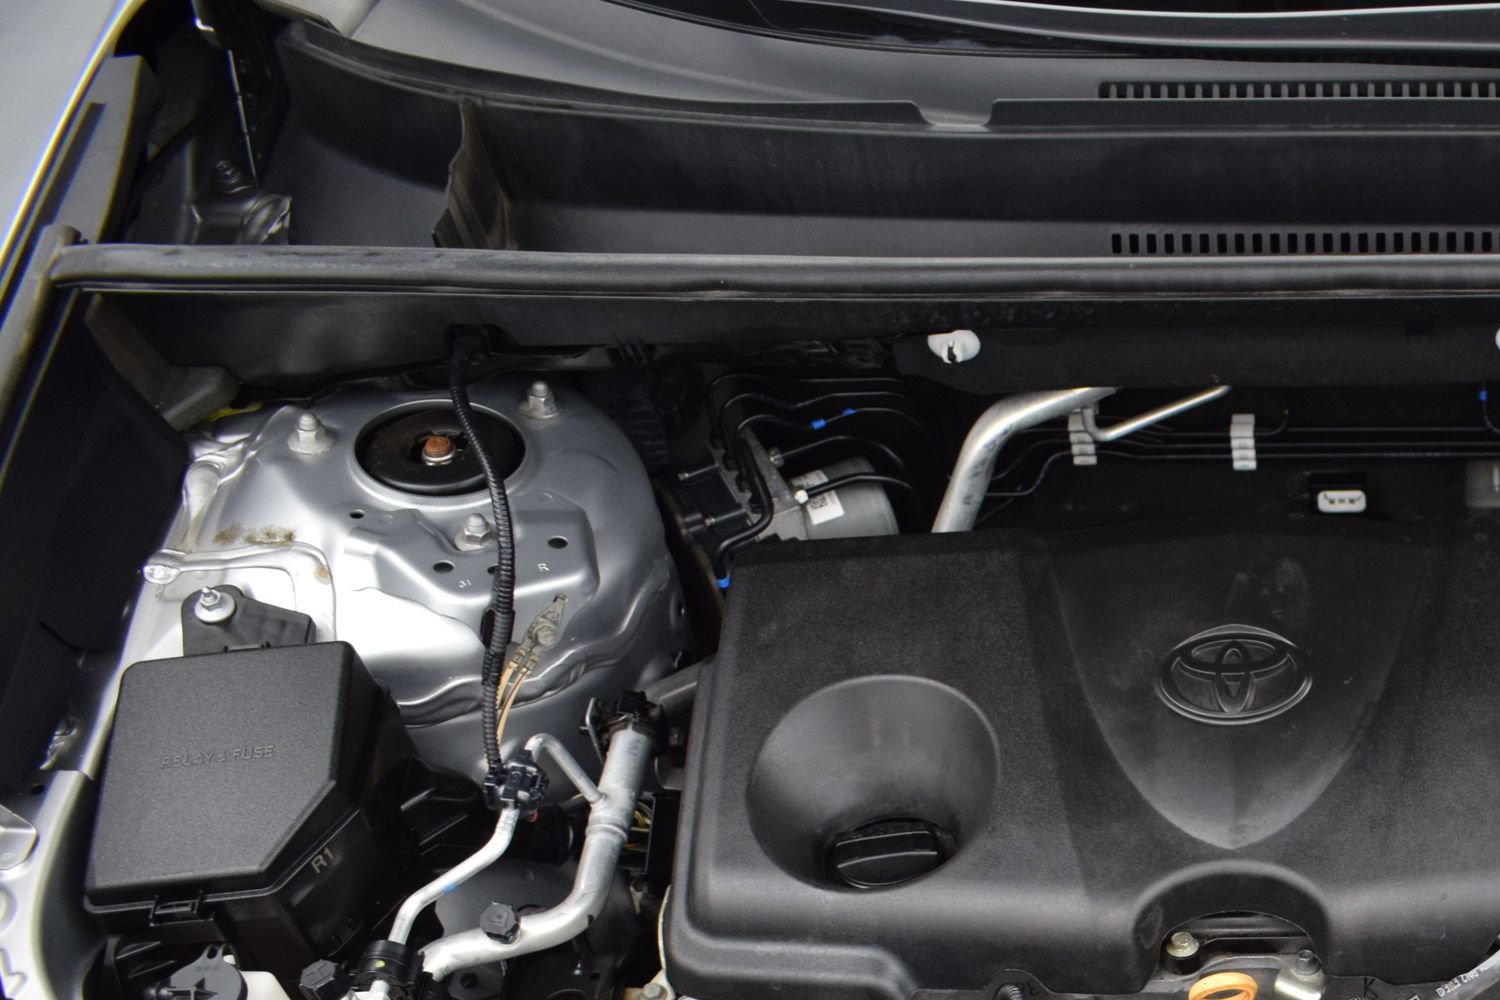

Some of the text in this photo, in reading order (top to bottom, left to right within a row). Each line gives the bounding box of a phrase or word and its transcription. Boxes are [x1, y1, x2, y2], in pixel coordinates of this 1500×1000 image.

[160, 752, 215, 770] RELAY
[233, 744, 276, 761] FUSE
[311, 846, 334, 874] R1
